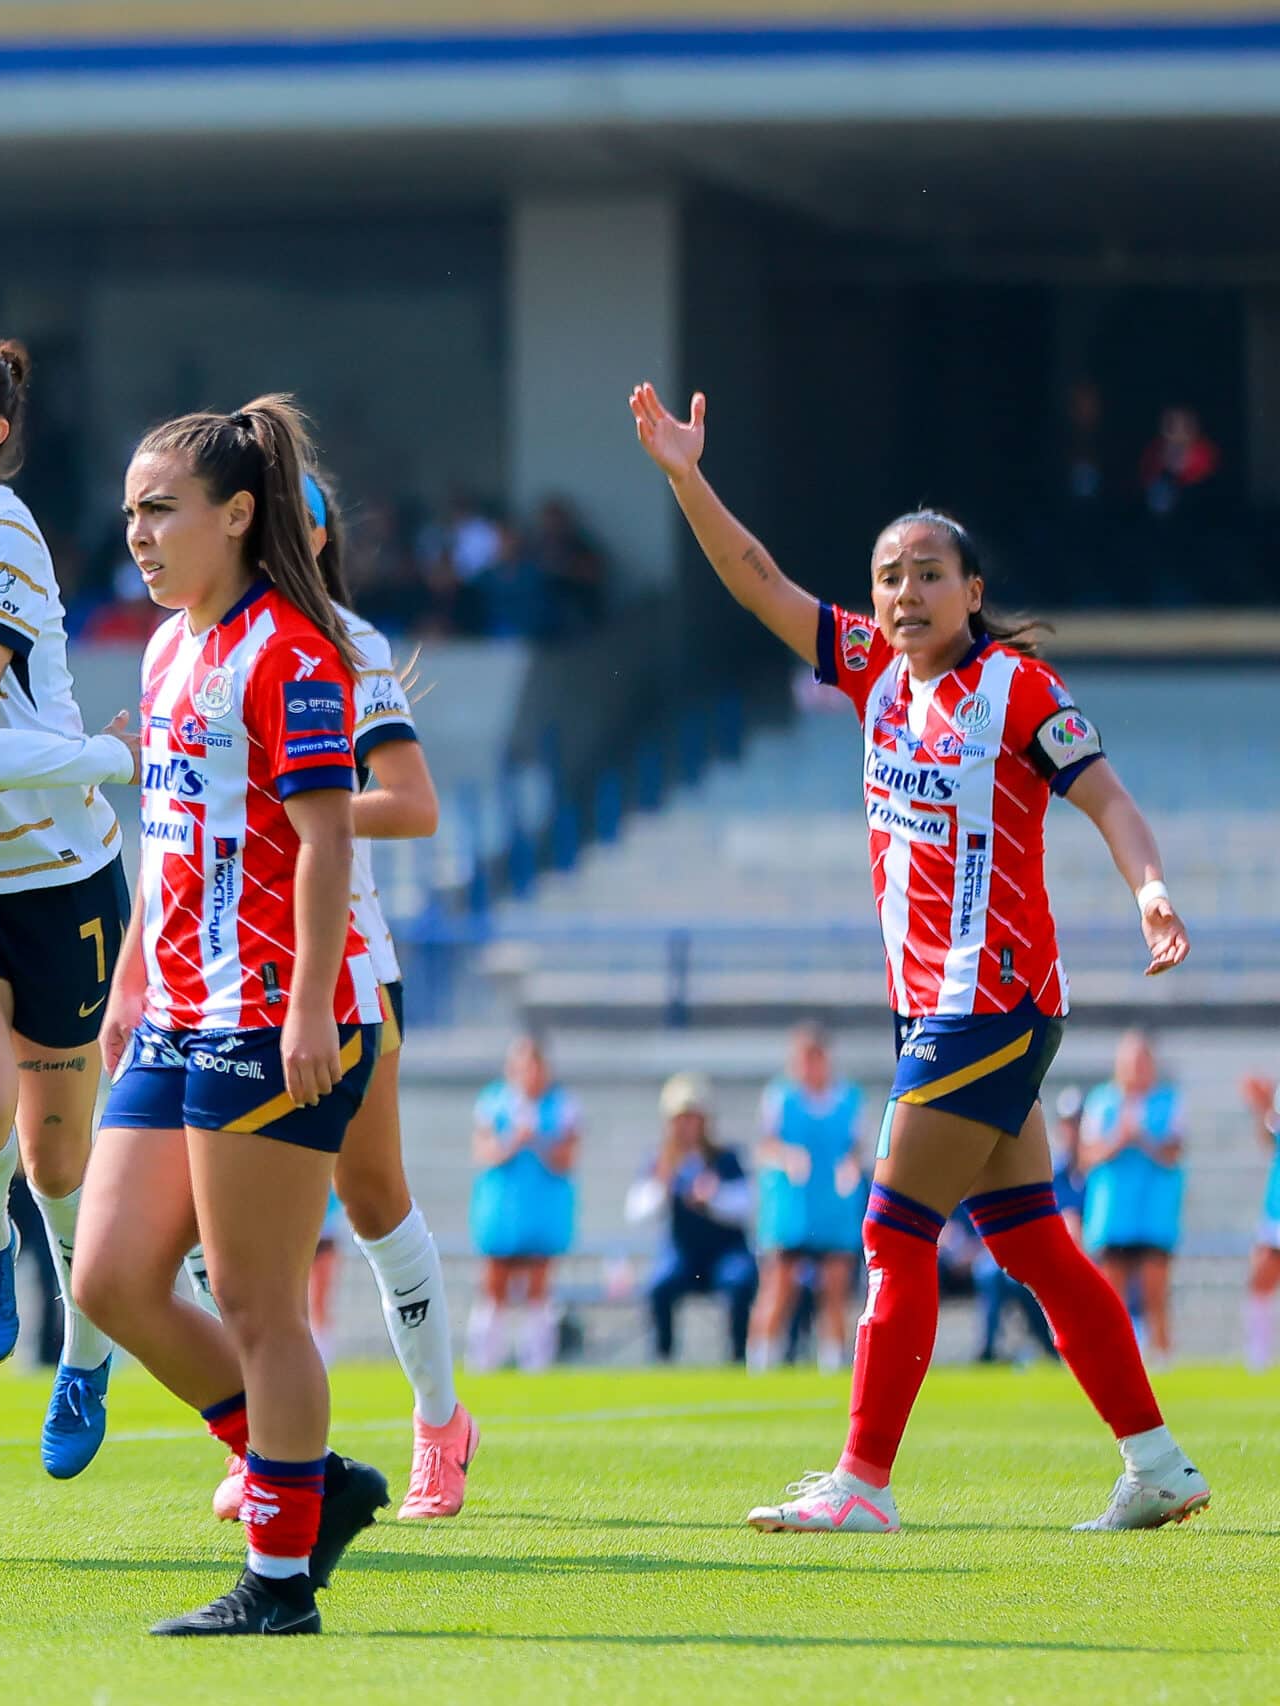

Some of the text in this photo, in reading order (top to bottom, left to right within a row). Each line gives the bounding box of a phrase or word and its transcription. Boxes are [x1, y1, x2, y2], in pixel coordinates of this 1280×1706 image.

[288, 742, 323, 755] Primera
[867, 749, 953, 800] Canel's
[79, 917, 106, 983] 7
